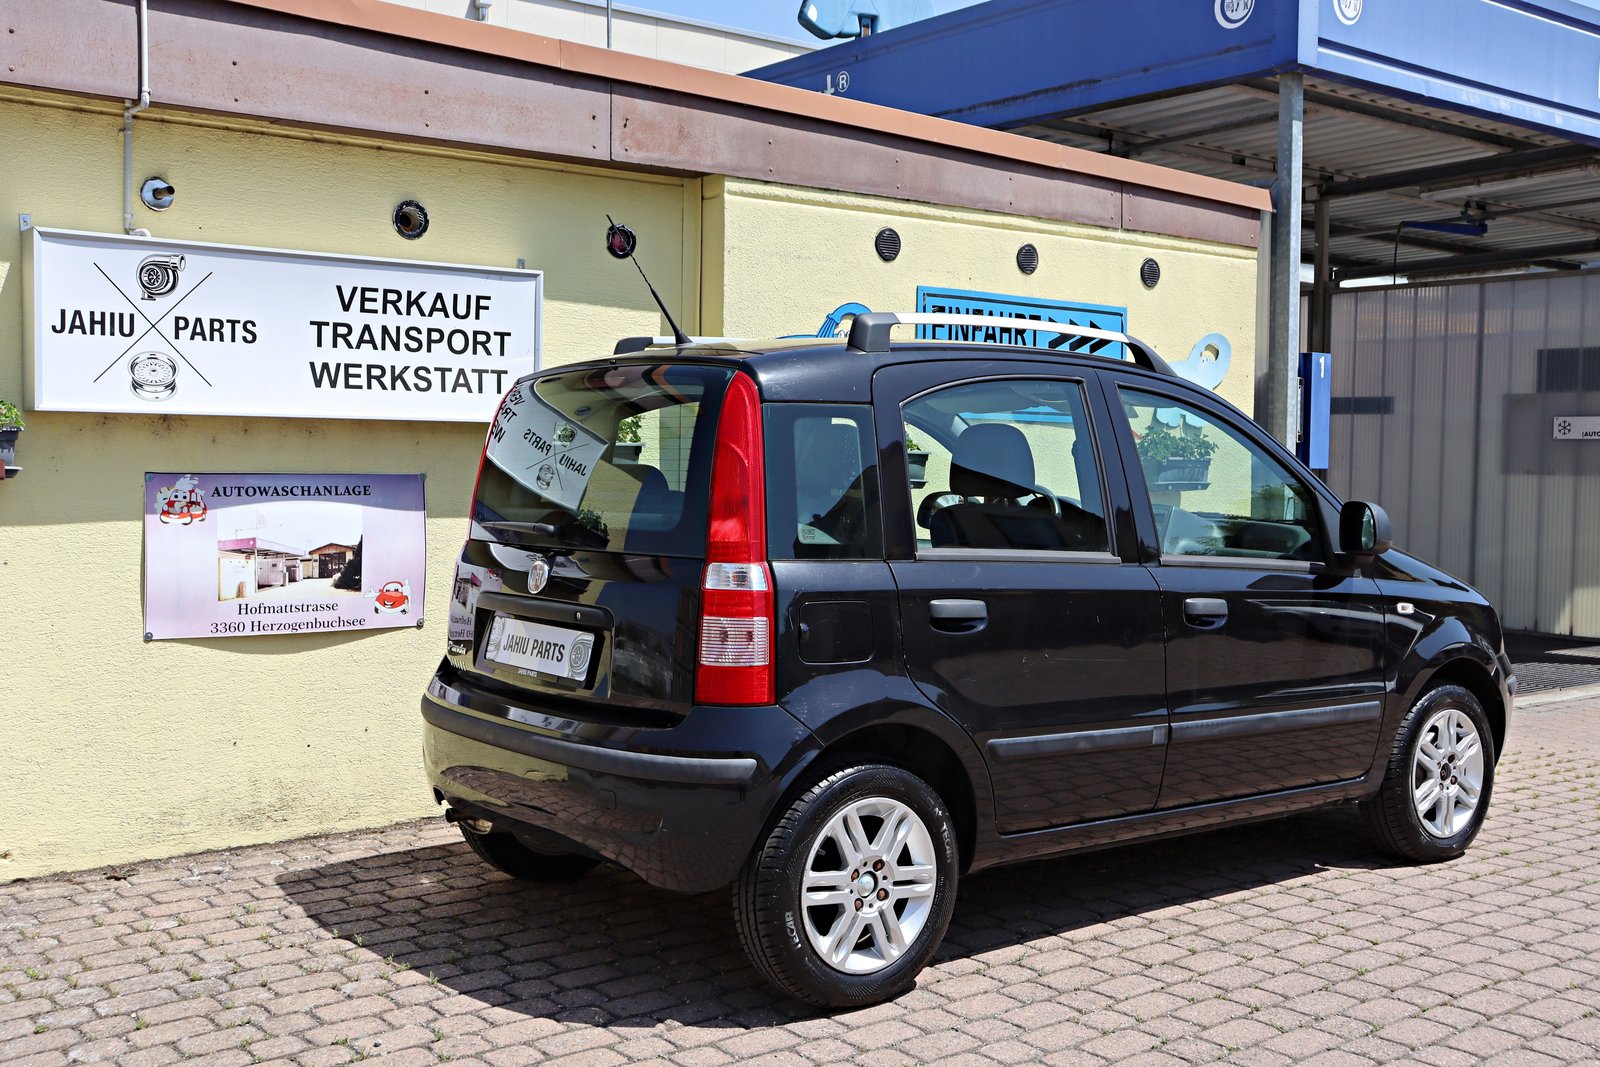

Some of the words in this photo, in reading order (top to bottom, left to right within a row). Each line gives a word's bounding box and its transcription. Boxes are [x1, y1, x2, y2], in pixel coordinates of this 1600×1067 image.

[335, 285, 492, 321] VERKAUF
[51, 308, 135, 338] JAHIU
[173, 316, 258, 344] PARTS
[309, 321, 512, 357] TRANSPORT
[309, 361, 508, 395] WERKSTATT
[1320, 356, 1325, 378] 1
[211, 484, 371, 498] AUTOWASCHANLAGE
[237, 601, 339, 616] Hofmattstrasse
[210, 622, 245, 634] 3360
[250, 616, 366, 634] Herzogenbuchsee
[503, 634, 530, 656] JAHIU
[530, 639, 566, 663] PARTS
